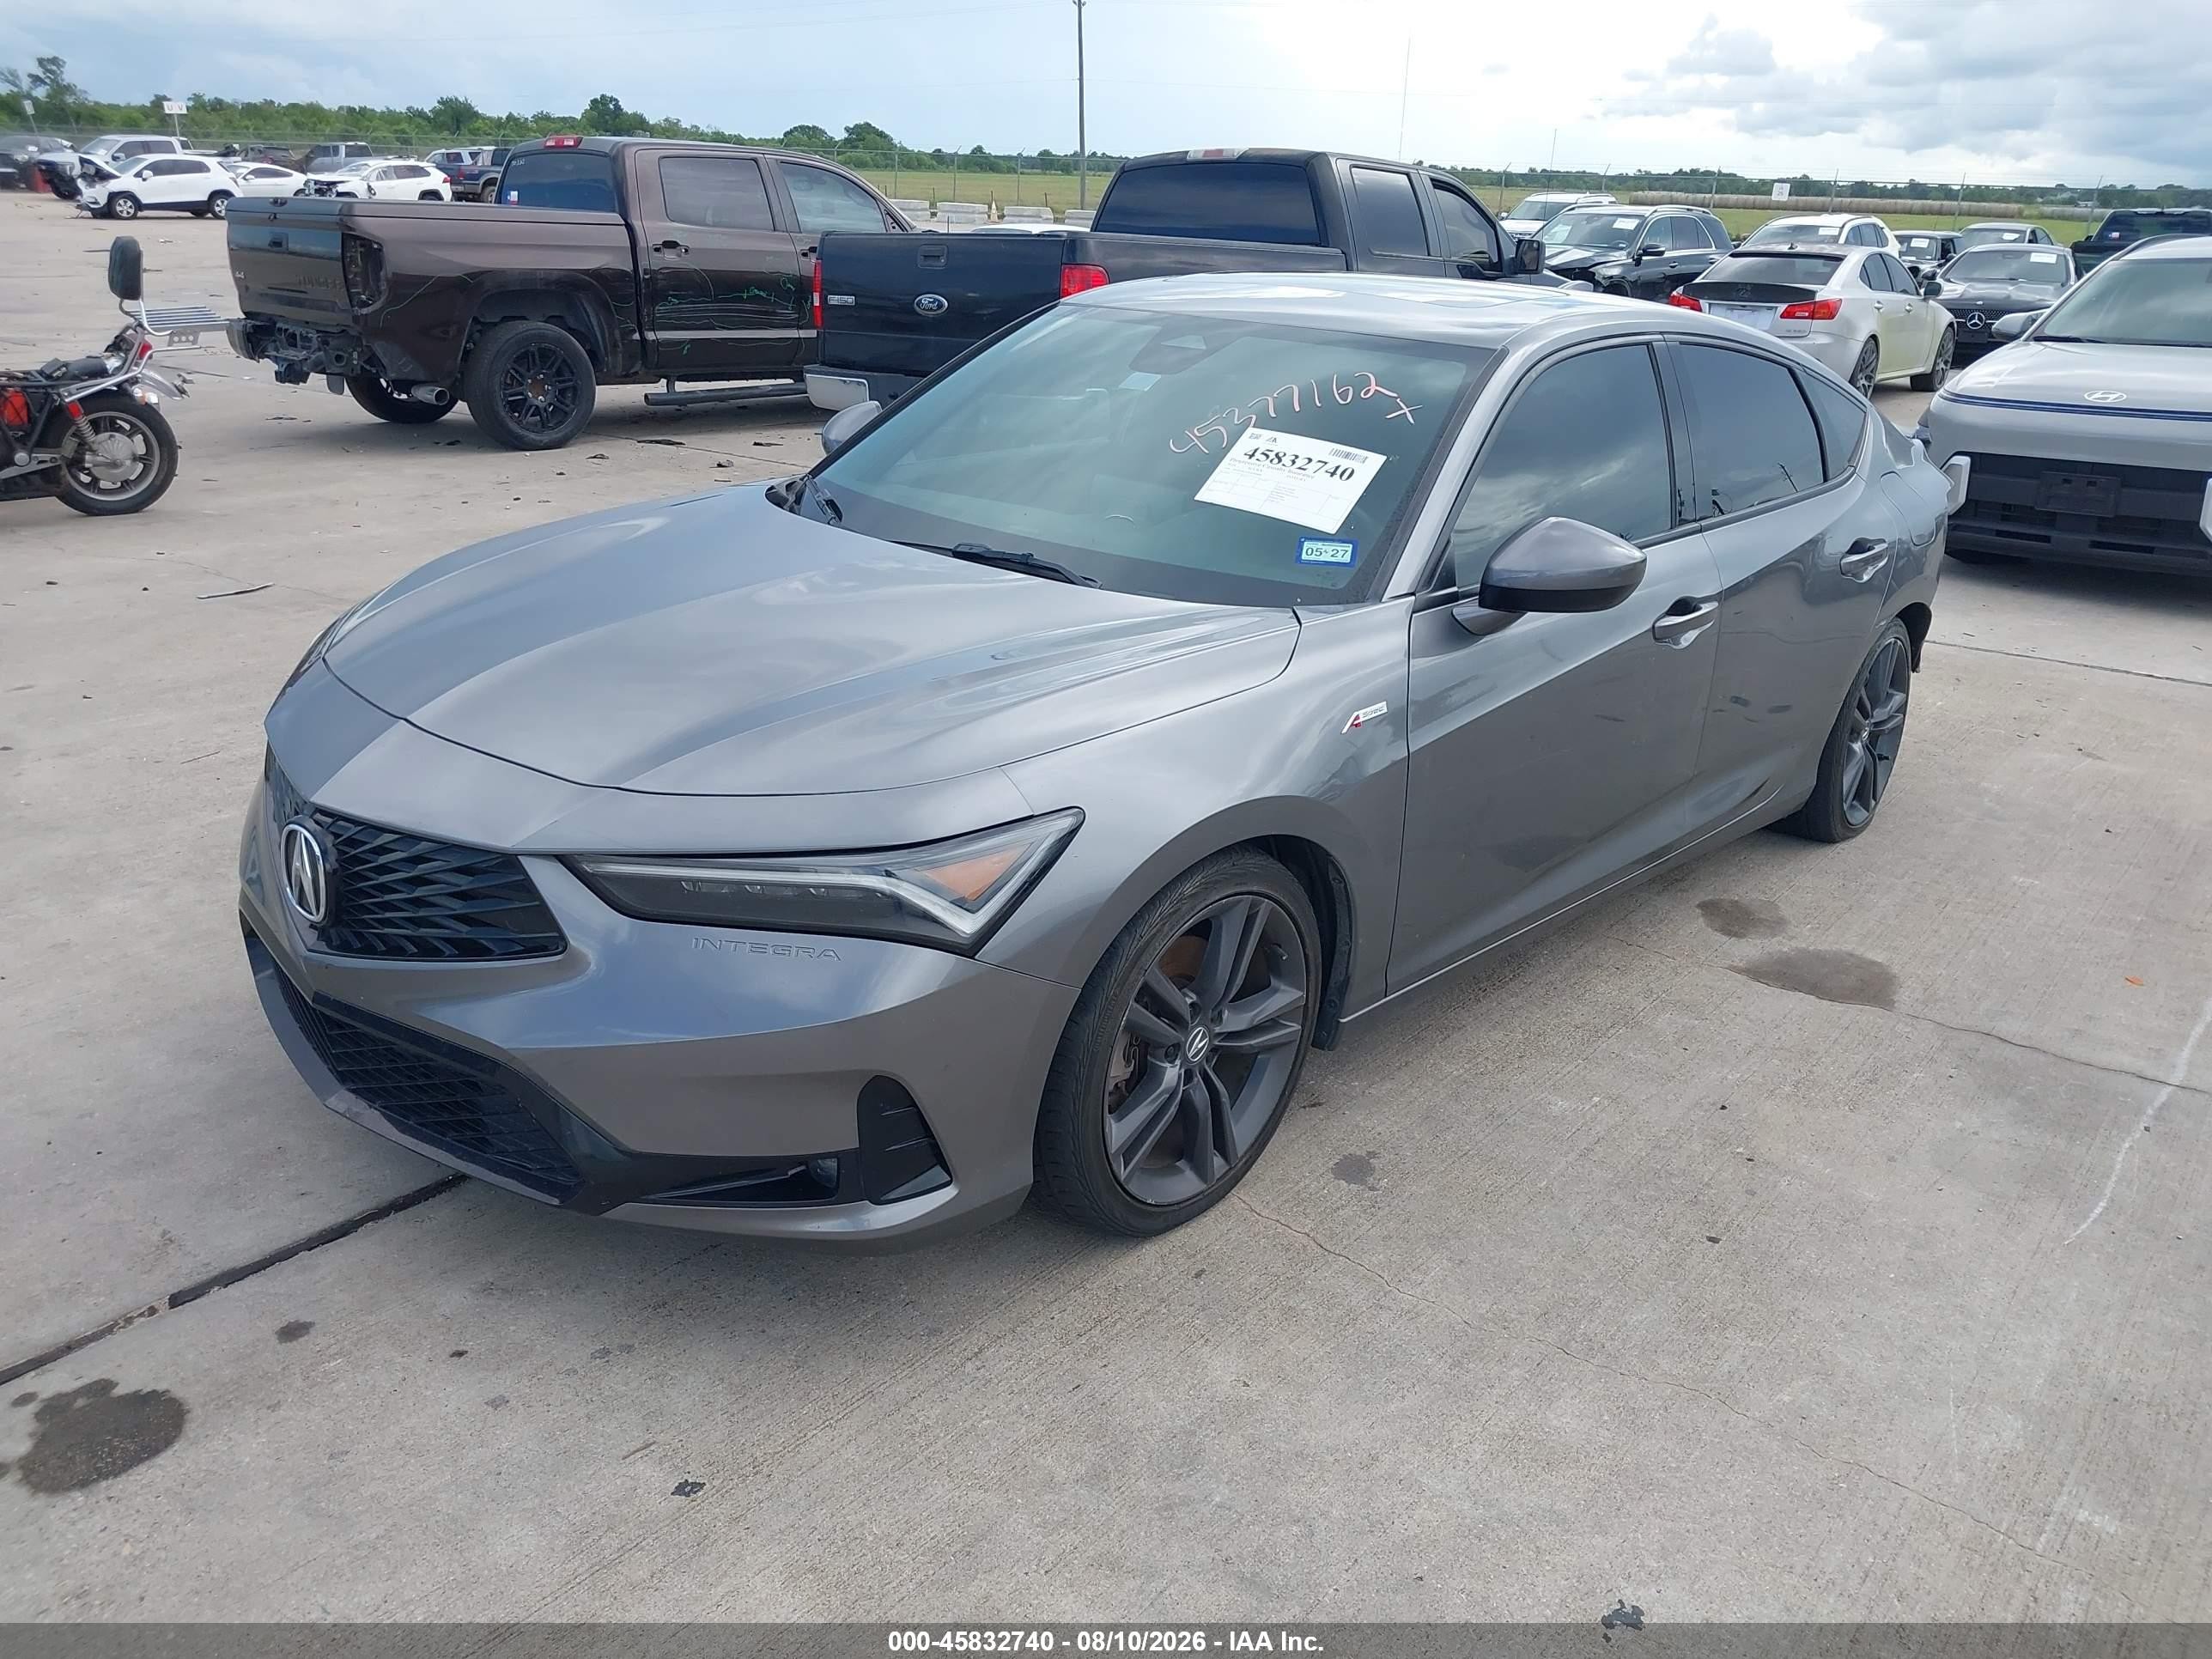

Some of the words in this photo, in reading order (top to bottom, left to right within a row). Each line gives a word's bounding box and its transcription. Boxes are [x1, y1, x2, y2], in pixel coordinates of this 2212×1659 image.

[920, 297, 939, 311] Ford
[1243, 447, 1355, 482] 45832740
[1305, 547, 1322, 557] 05
[1330, 549, 1349, 559] 27
[692, 937, 842, 961] INTEGRA
